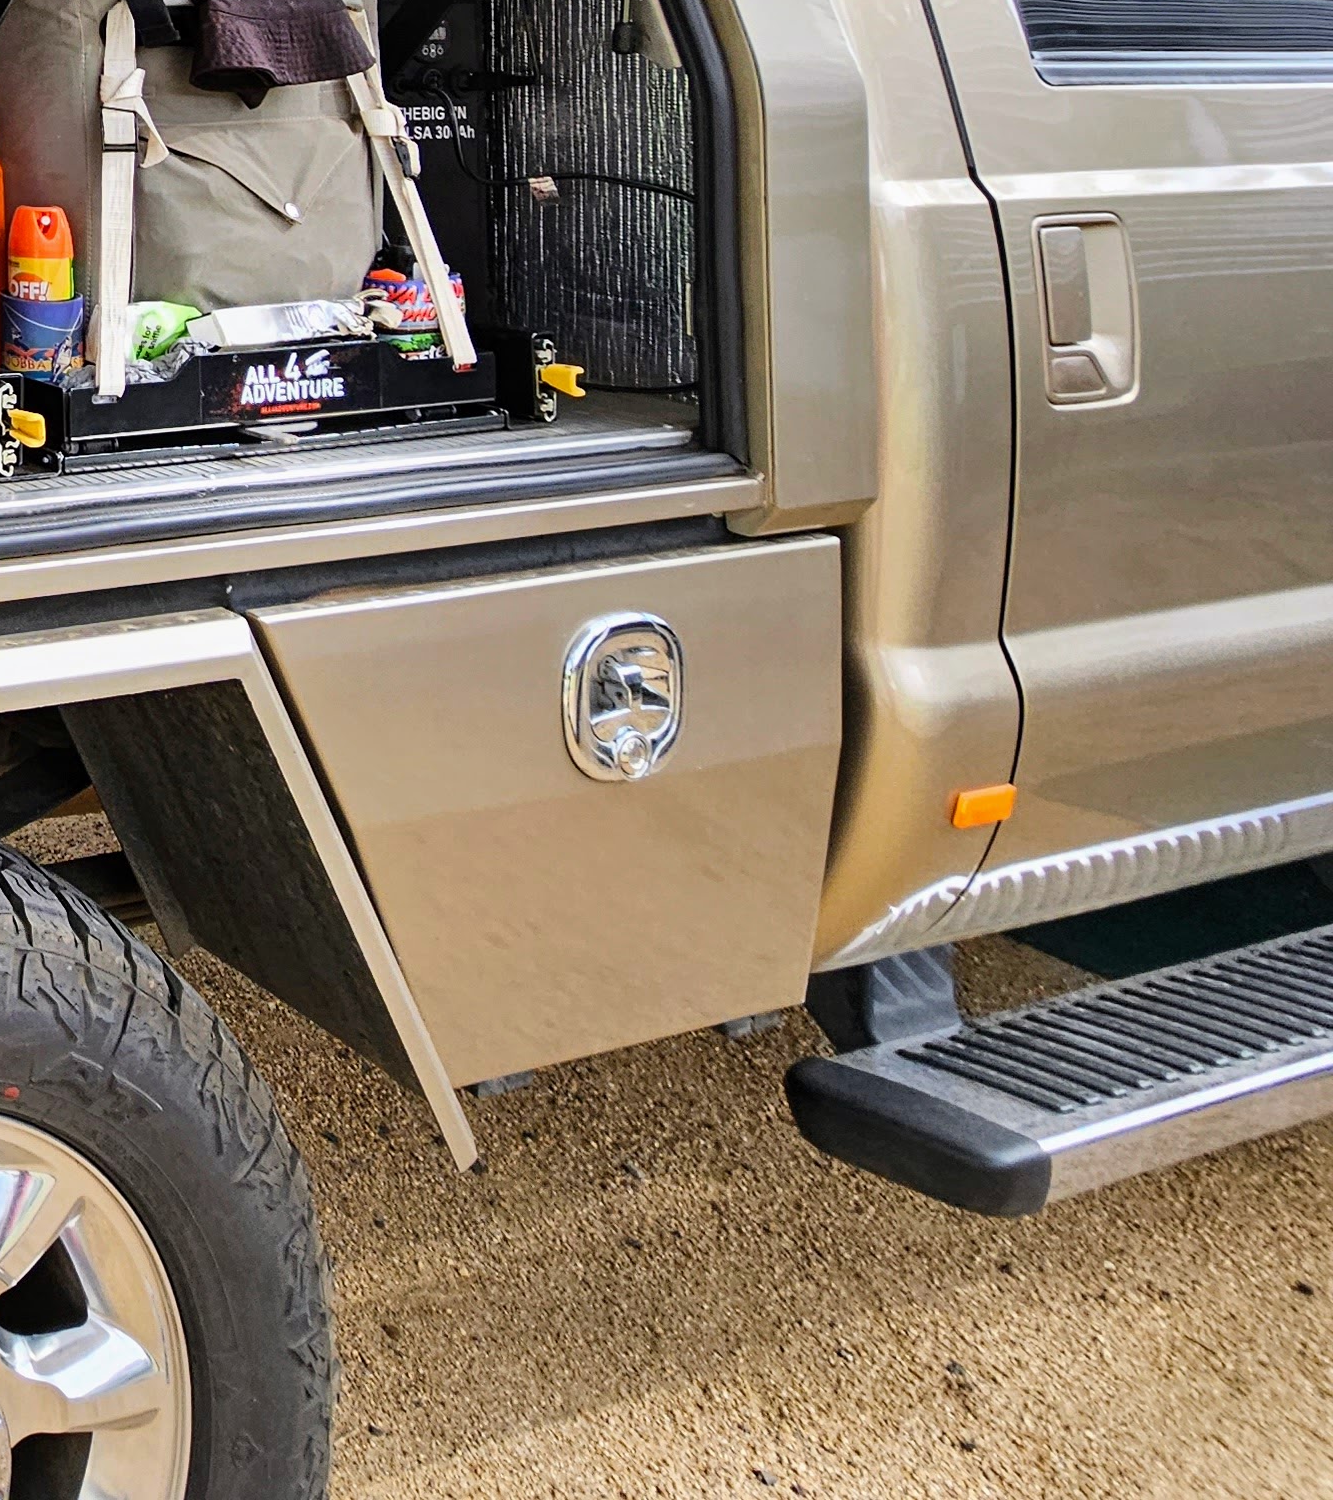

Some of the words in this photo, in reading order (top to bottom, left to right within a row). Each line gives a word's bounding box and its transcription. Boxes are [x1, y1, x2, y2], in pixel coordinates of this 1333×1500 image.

[435, 125, 475, 139] 30Ah
[9, 279, 49, 301] OFF!
[245, 364, 281, 386] ALL
[284, 352, 302, 381] 4
[240, 377, 345, 405] ADVENTURE
